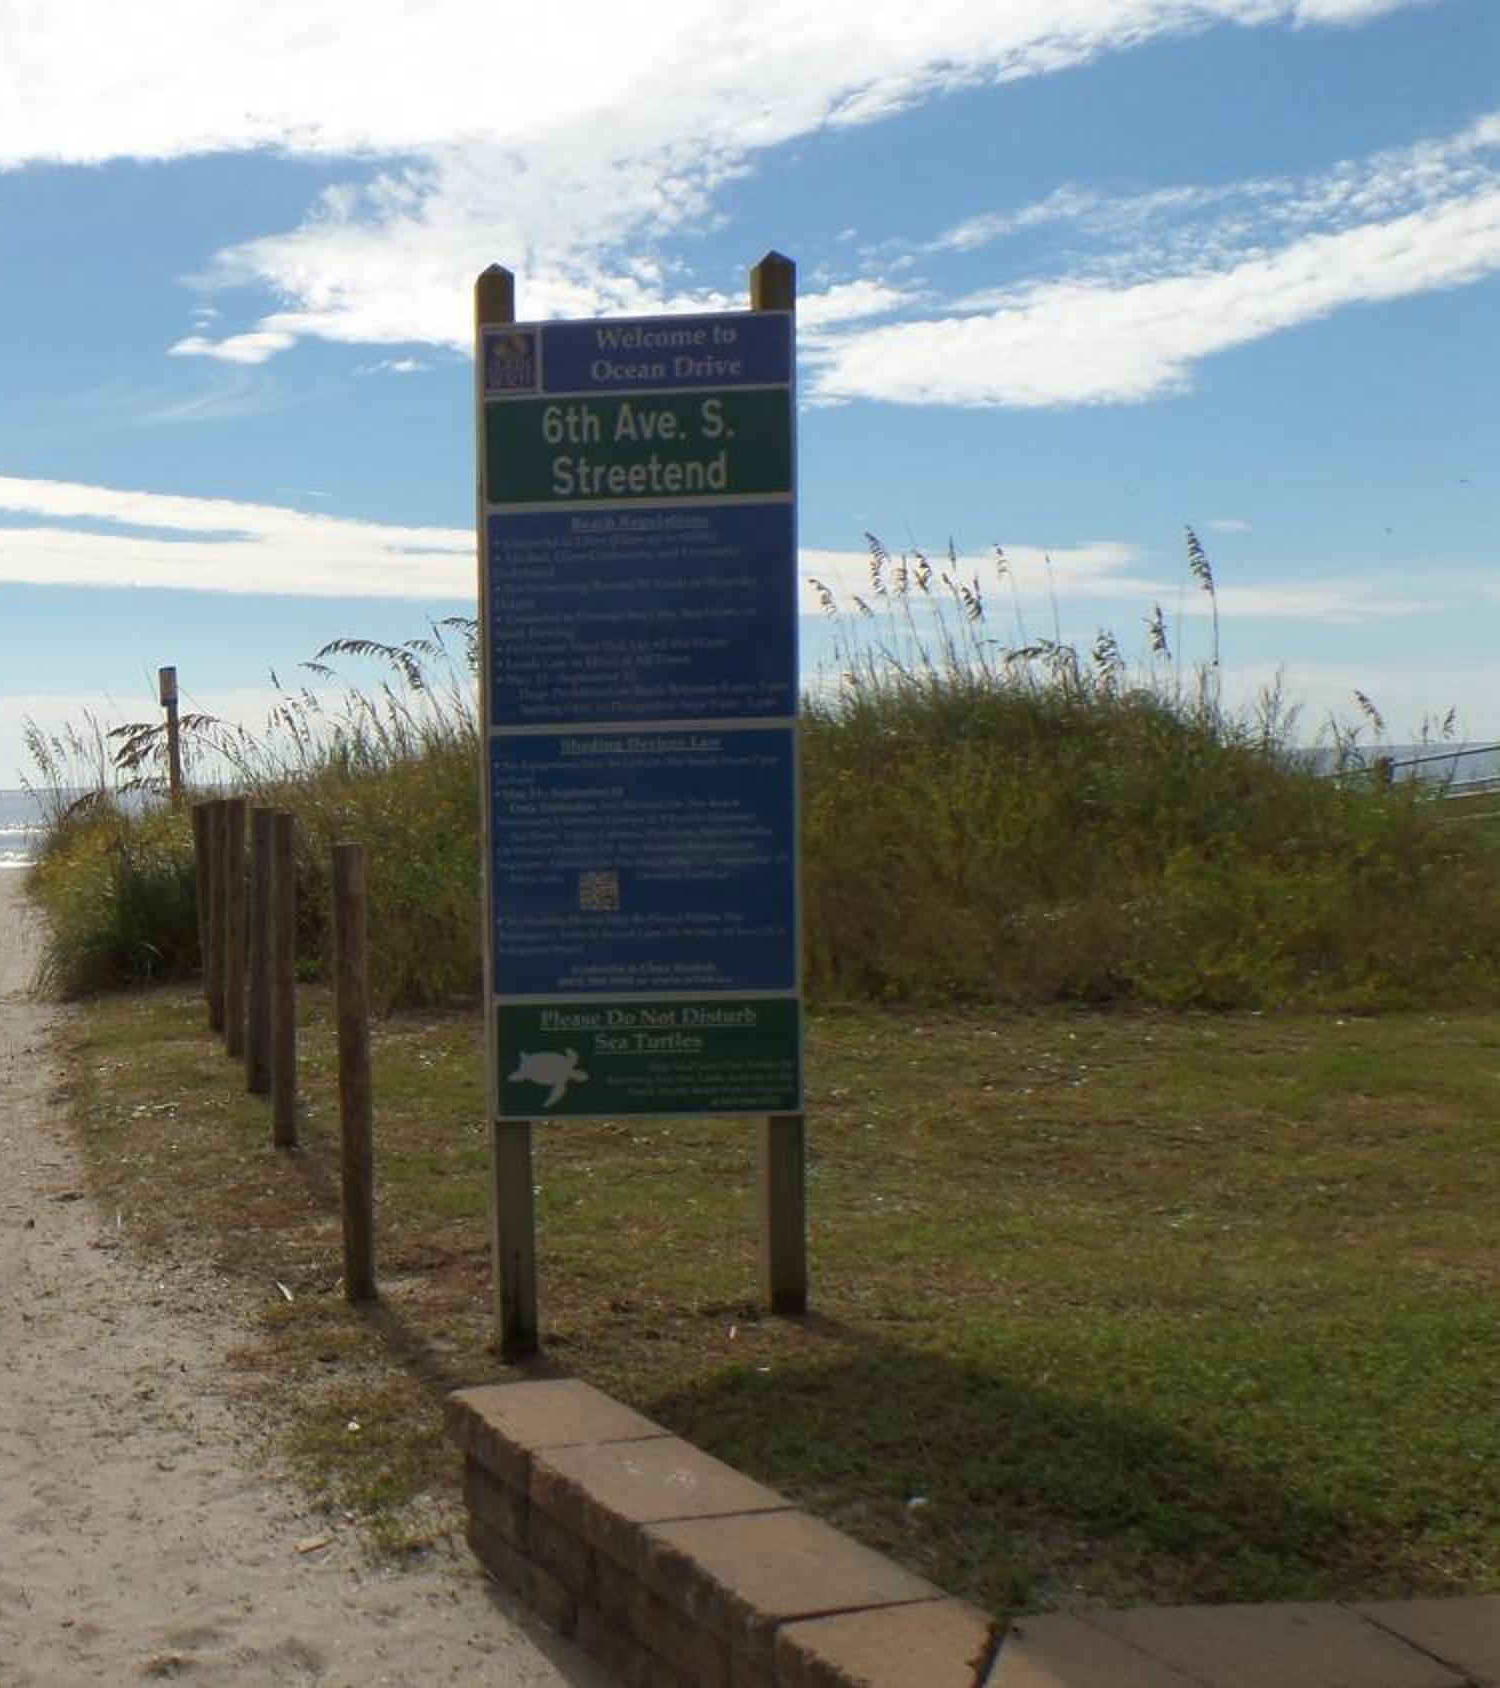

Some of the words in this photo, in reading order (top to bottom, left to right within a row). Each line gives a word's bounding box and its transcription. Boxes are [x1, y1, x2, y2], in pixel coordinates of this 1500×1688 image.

[596, 326, 707, 349] Welcome
[713, 324, 737, 344] to
[592, 358, 665, 381] Ocean
[674, 354, 741, 377] Drive
[542, 405, 600, 444] 6th
[614, 402, 687, 442] Ave.
[702, 399, 735, 438] S.
[553, 452, 728, 497] Streetend
[539, 1010, 600, 1029] Please
[607, 1010, 637, 1027] Do
[641, 1008, 677, 1026] Not
[683, 1007, 758, 1026] Disturb
[595, 1033, 629, 1052] Sea
[637, 1032, 703, 1052] Turtles
